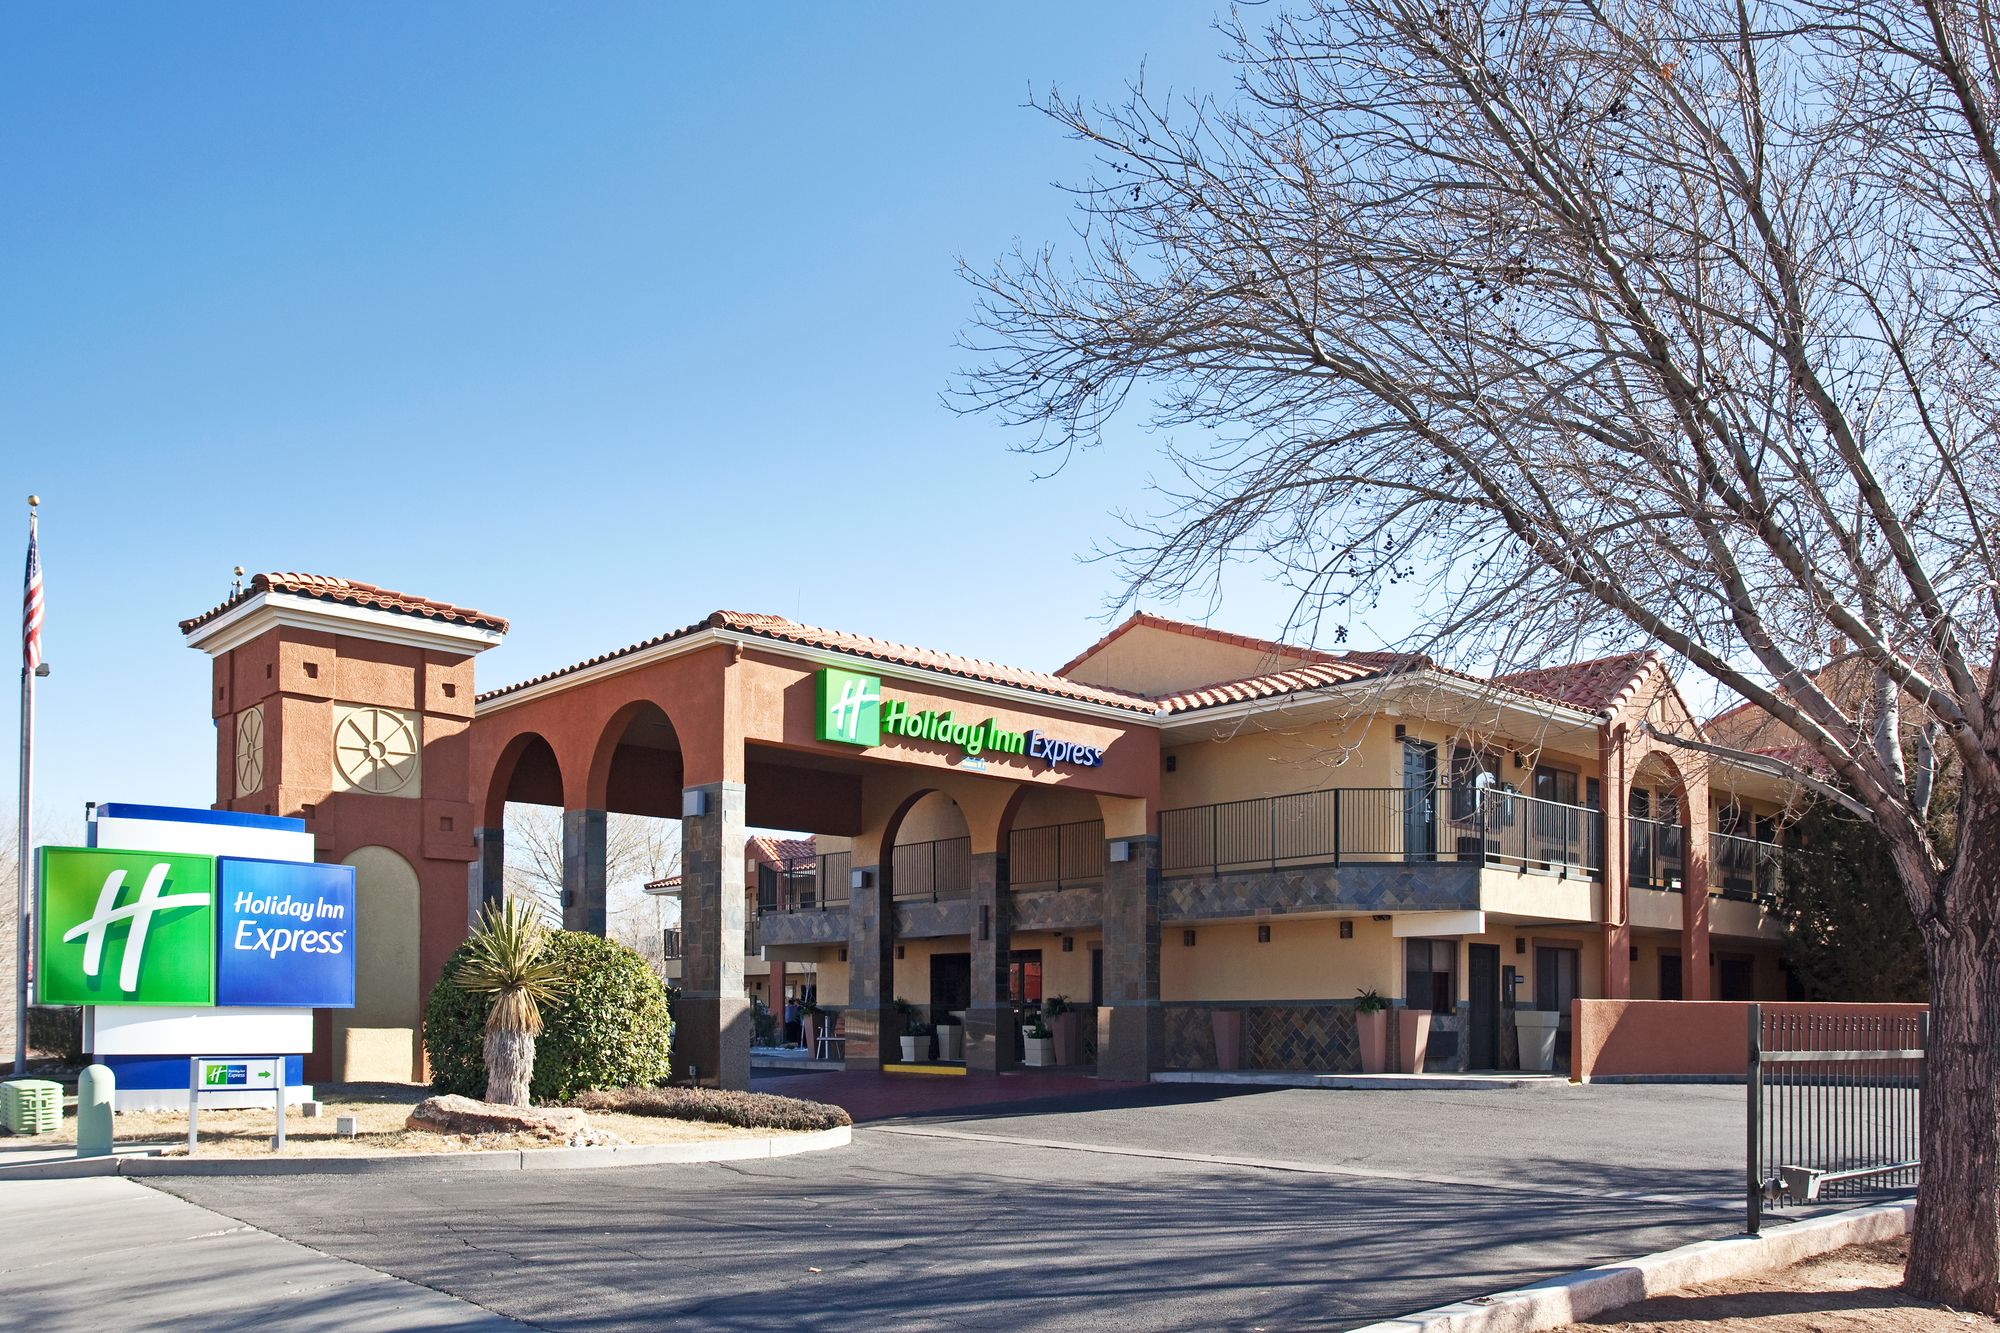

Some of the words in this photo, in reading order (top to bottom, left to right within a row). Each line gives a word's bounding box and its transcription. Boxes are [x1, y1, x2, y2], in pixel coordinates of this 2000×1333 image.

[885, 699, 985, 756] Holiday
[988, 716, 1025, 755] Inn
[233, 891, 315, 922] Holiday
[316, 896, 345, 920] Inn
[233, 919, 344, 960] Express
